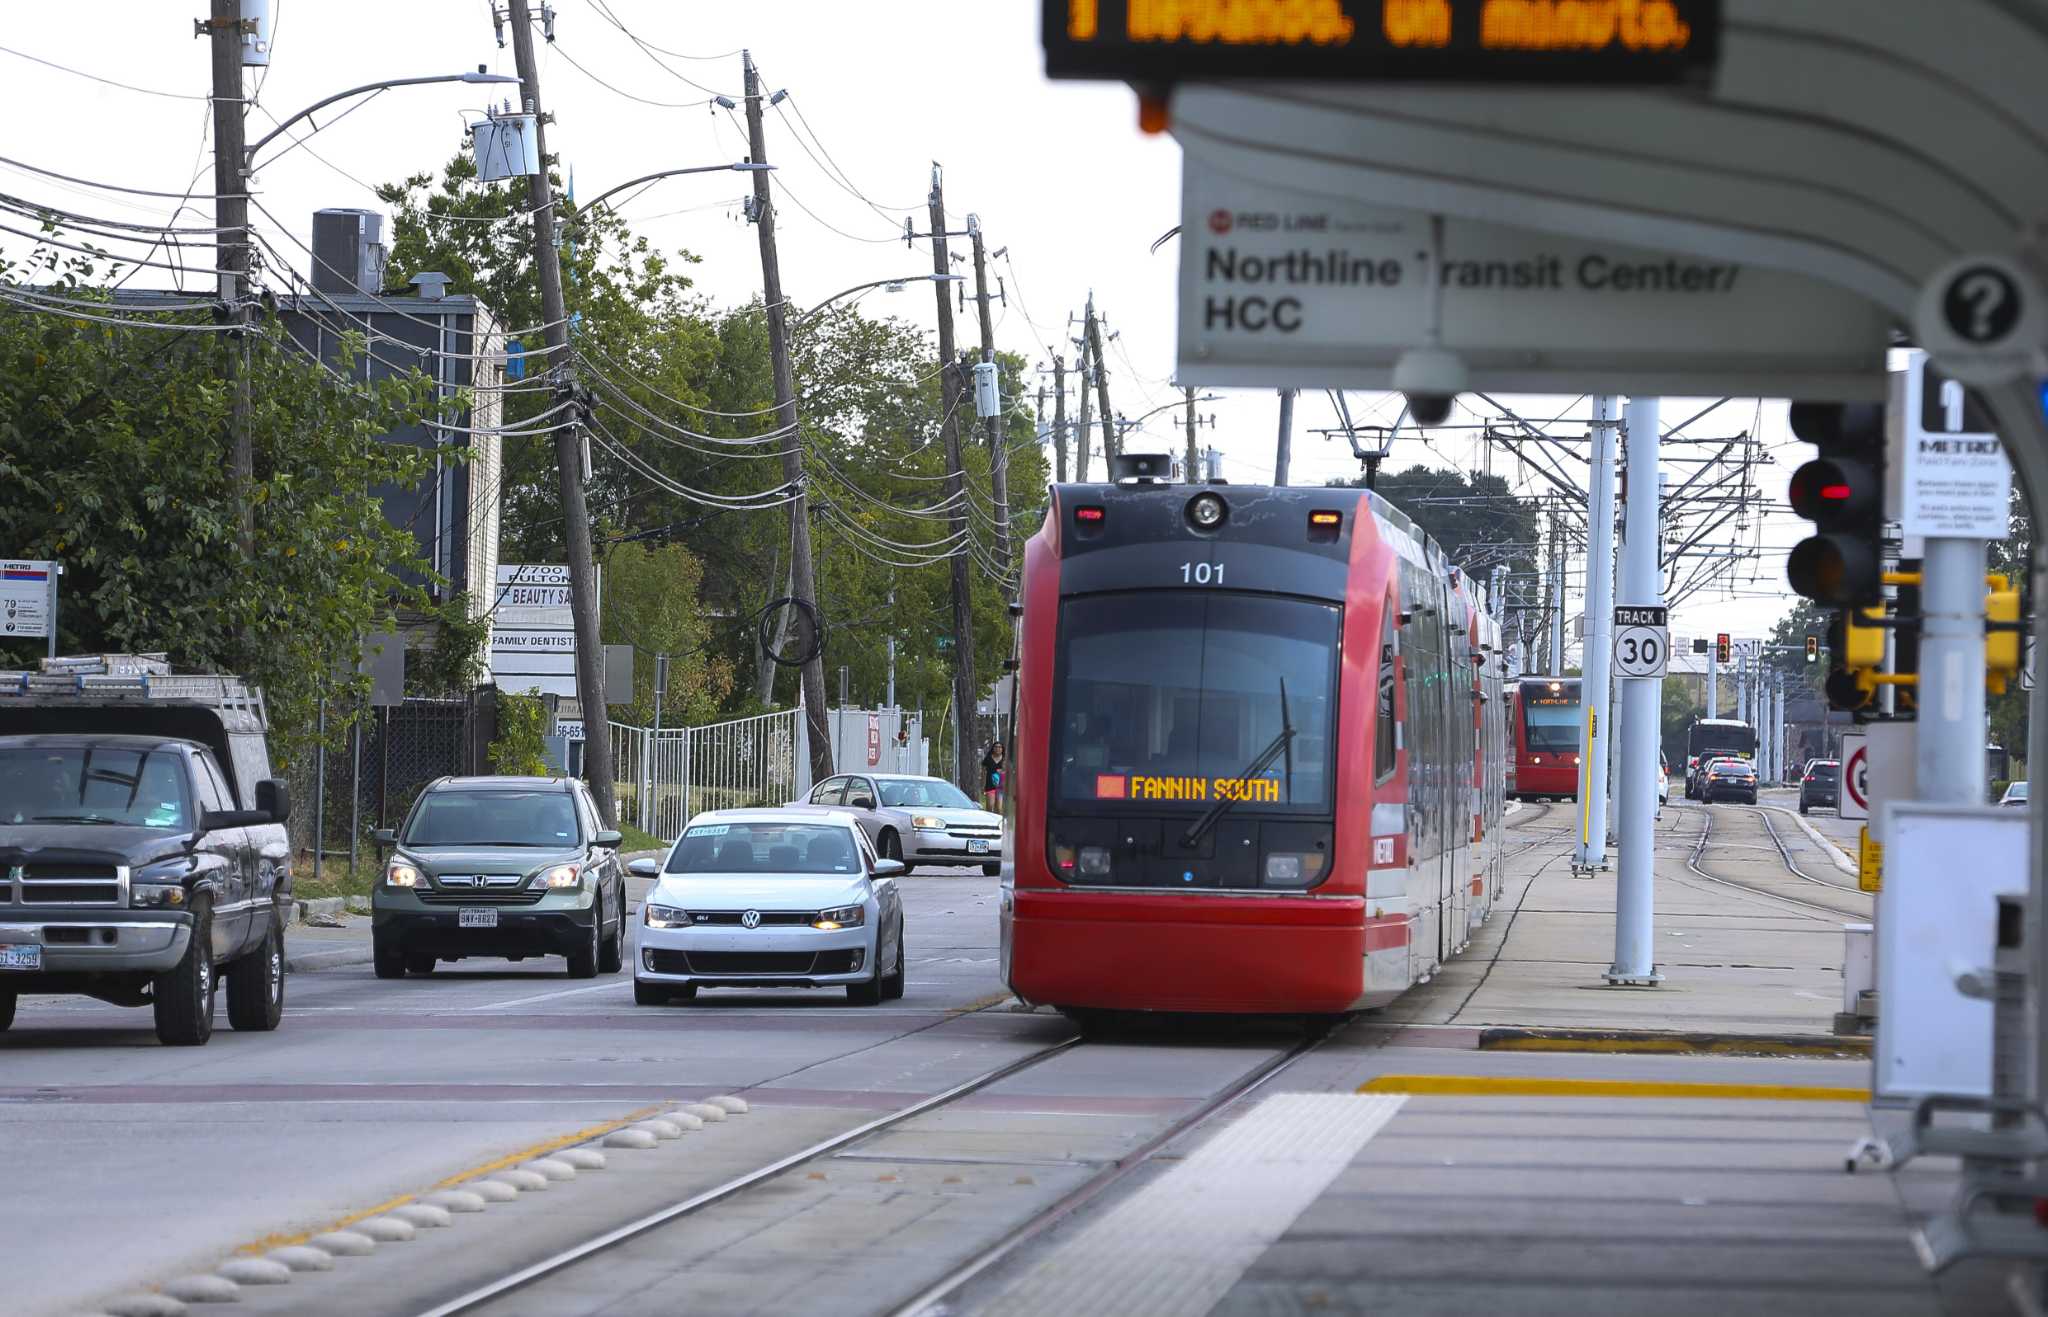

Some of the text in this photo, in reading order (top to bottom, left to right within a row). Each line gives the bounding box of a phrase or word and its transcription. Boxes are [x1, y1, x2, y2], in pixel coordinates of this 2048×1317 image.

[1206, 248, 1404, 286] Northline
[1415, 252, 1563, 290] ransit
[1204, 297, 1303, 332] HCC
[521, 566, 562, 574] 7700
[1180, 562, 1224, 584] 101
[513, 588, 555, 604] BEAUTY
[1617, 610, 1665, 625] TRACK 1
[493, 636, 527, 645] FAMILY
[1622, 637, 1658, 665] 30
[1131, 776, 1279, 802] FANNIN SOUTH
